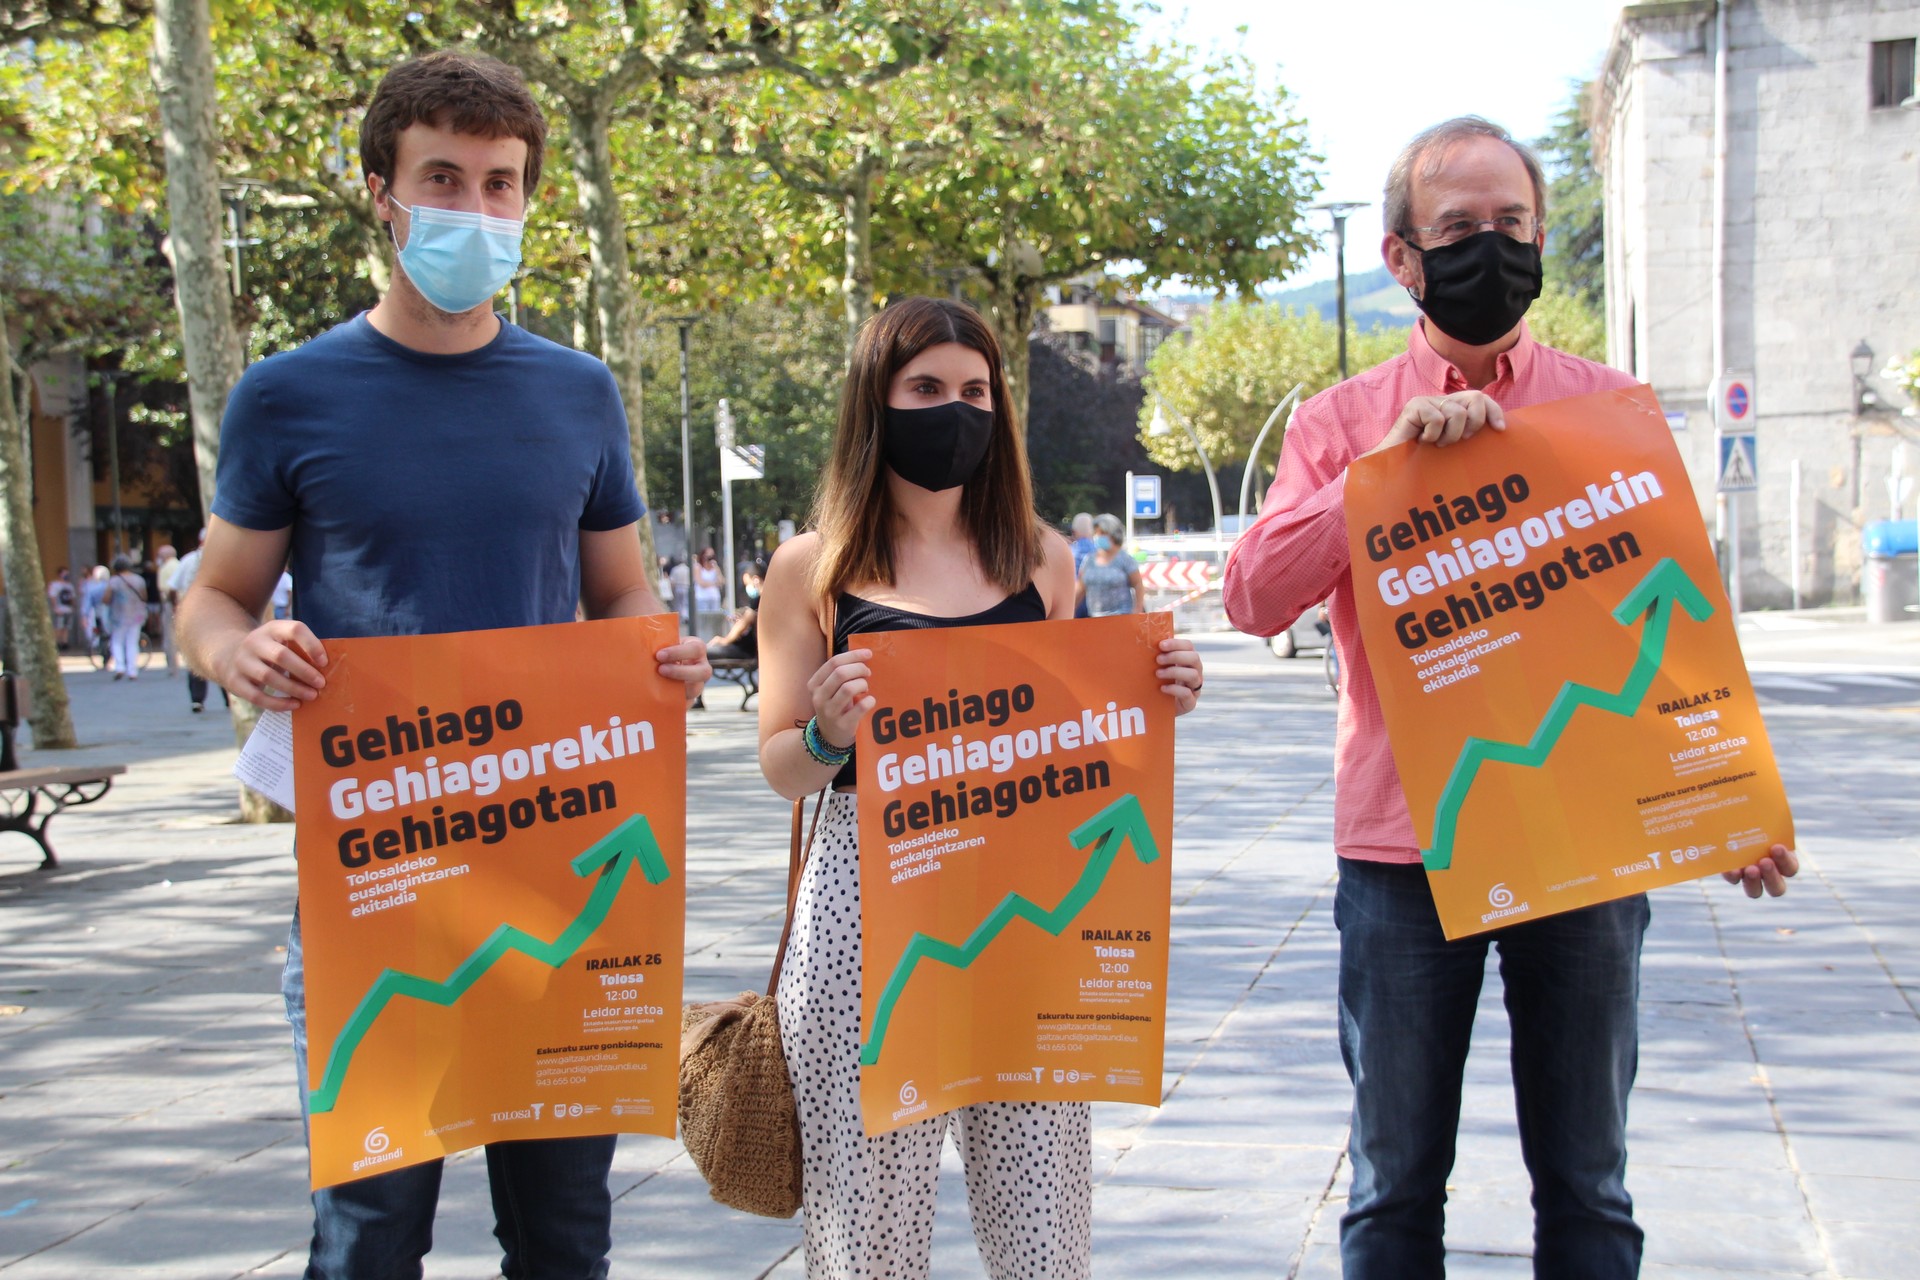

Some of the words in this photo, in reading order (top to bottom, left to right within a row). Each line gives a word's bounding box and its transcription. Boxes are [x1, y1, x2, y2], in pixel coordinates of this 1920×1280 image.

[1365, 473, 1530, 562] Gehiago
[1377, 469, 1664, 607] Gehiagorekin
[1394, 530, 1642, 649] Gehiagotan
[1409, 627, 1489, 666] Tolosaldeko
[1416, 629, 1521, 680] euskalgintzaren
[1422, 662, 1480, 694] ekitaldia
[1657, 692, 1712, 715] IRAILAK
[1714, 687, 1731, 700] 26
[871, 683, 1035, 745] Gehiago
[1674, 709, 1719, 728] Tolosa
[320, 698, 523, 768] Gehiago
[1685, 726, 1717, 742] 12:00
[876, 701, 1146, 792] Gehiagorekin
[1669, 746, 1706, 762] Leidor
[1708, 736, 1747, 753] aretoa
[329, 716, 655, 820] Gehiagorekin
[883, 759, 1110, 838] Gehiagotan
[1636, 790, 1676, 805] Eskuratu
[1677, 785, 1696, 795] zure
[1697, 770, 1757, 791] gonbidapena:
[337, 780, 617, 868] Gehiagotan
[1645, 827, 1661, 836] 943
[1678, 819, 1694, 829] 004
[887, 827, 959, 856] Tolosaldeko
[889, 834, 985, 870] euskalgintzaren
[346, 854, 438, 886] Tolosaldeko
[349, 863, 470, 902] euskalgintzaren
[891, 859, 941, 884] ekitaldia
[351, 890, 417, 917] ekitaldia
[1481, 901, 1529, 923] galtzaundi
[1081, 930, 1133, 941] IRAILAK
[1136, 930, 1151, 941] 26
[586, 955, 642, 971] IRAILAK
[645, 953, 662, 965] 26
[1093, 946, 1135, 958] Tolosa
[600, 973, 644, 986] Tolosa
[1100, 963, 1129, 973] 12:00
[605, 989, 638, 1001] 12:00
[1079, 978, 1114, 988] Leidor
[1117, 979, 1152, 990] aretoa
[583, 1007, 621, 1019] Leidor
[624, 1004, 664, 1015] aretoa
[1096, 1012, 1151, 1022] gonbidapena:
[1037, 1023, 1112, 1031] www.galtzaundi.eus
[536, 1052, 618, 1065] www.galtzaundi.eus
[537, 1046, 578, 1055] Eskuratu
[600, 1040, 663, 1050] gonbidapena:
[536, 1062, 648, 1077] galtzaundi@galtzaundi.eus
[536, 1078, 551, 1086] 943
[552, 1077, 568, 1085] 655
[892, 1100, 928, 1120] galtzaundi
[352, 1147, 403, 1171] galtzaundi
